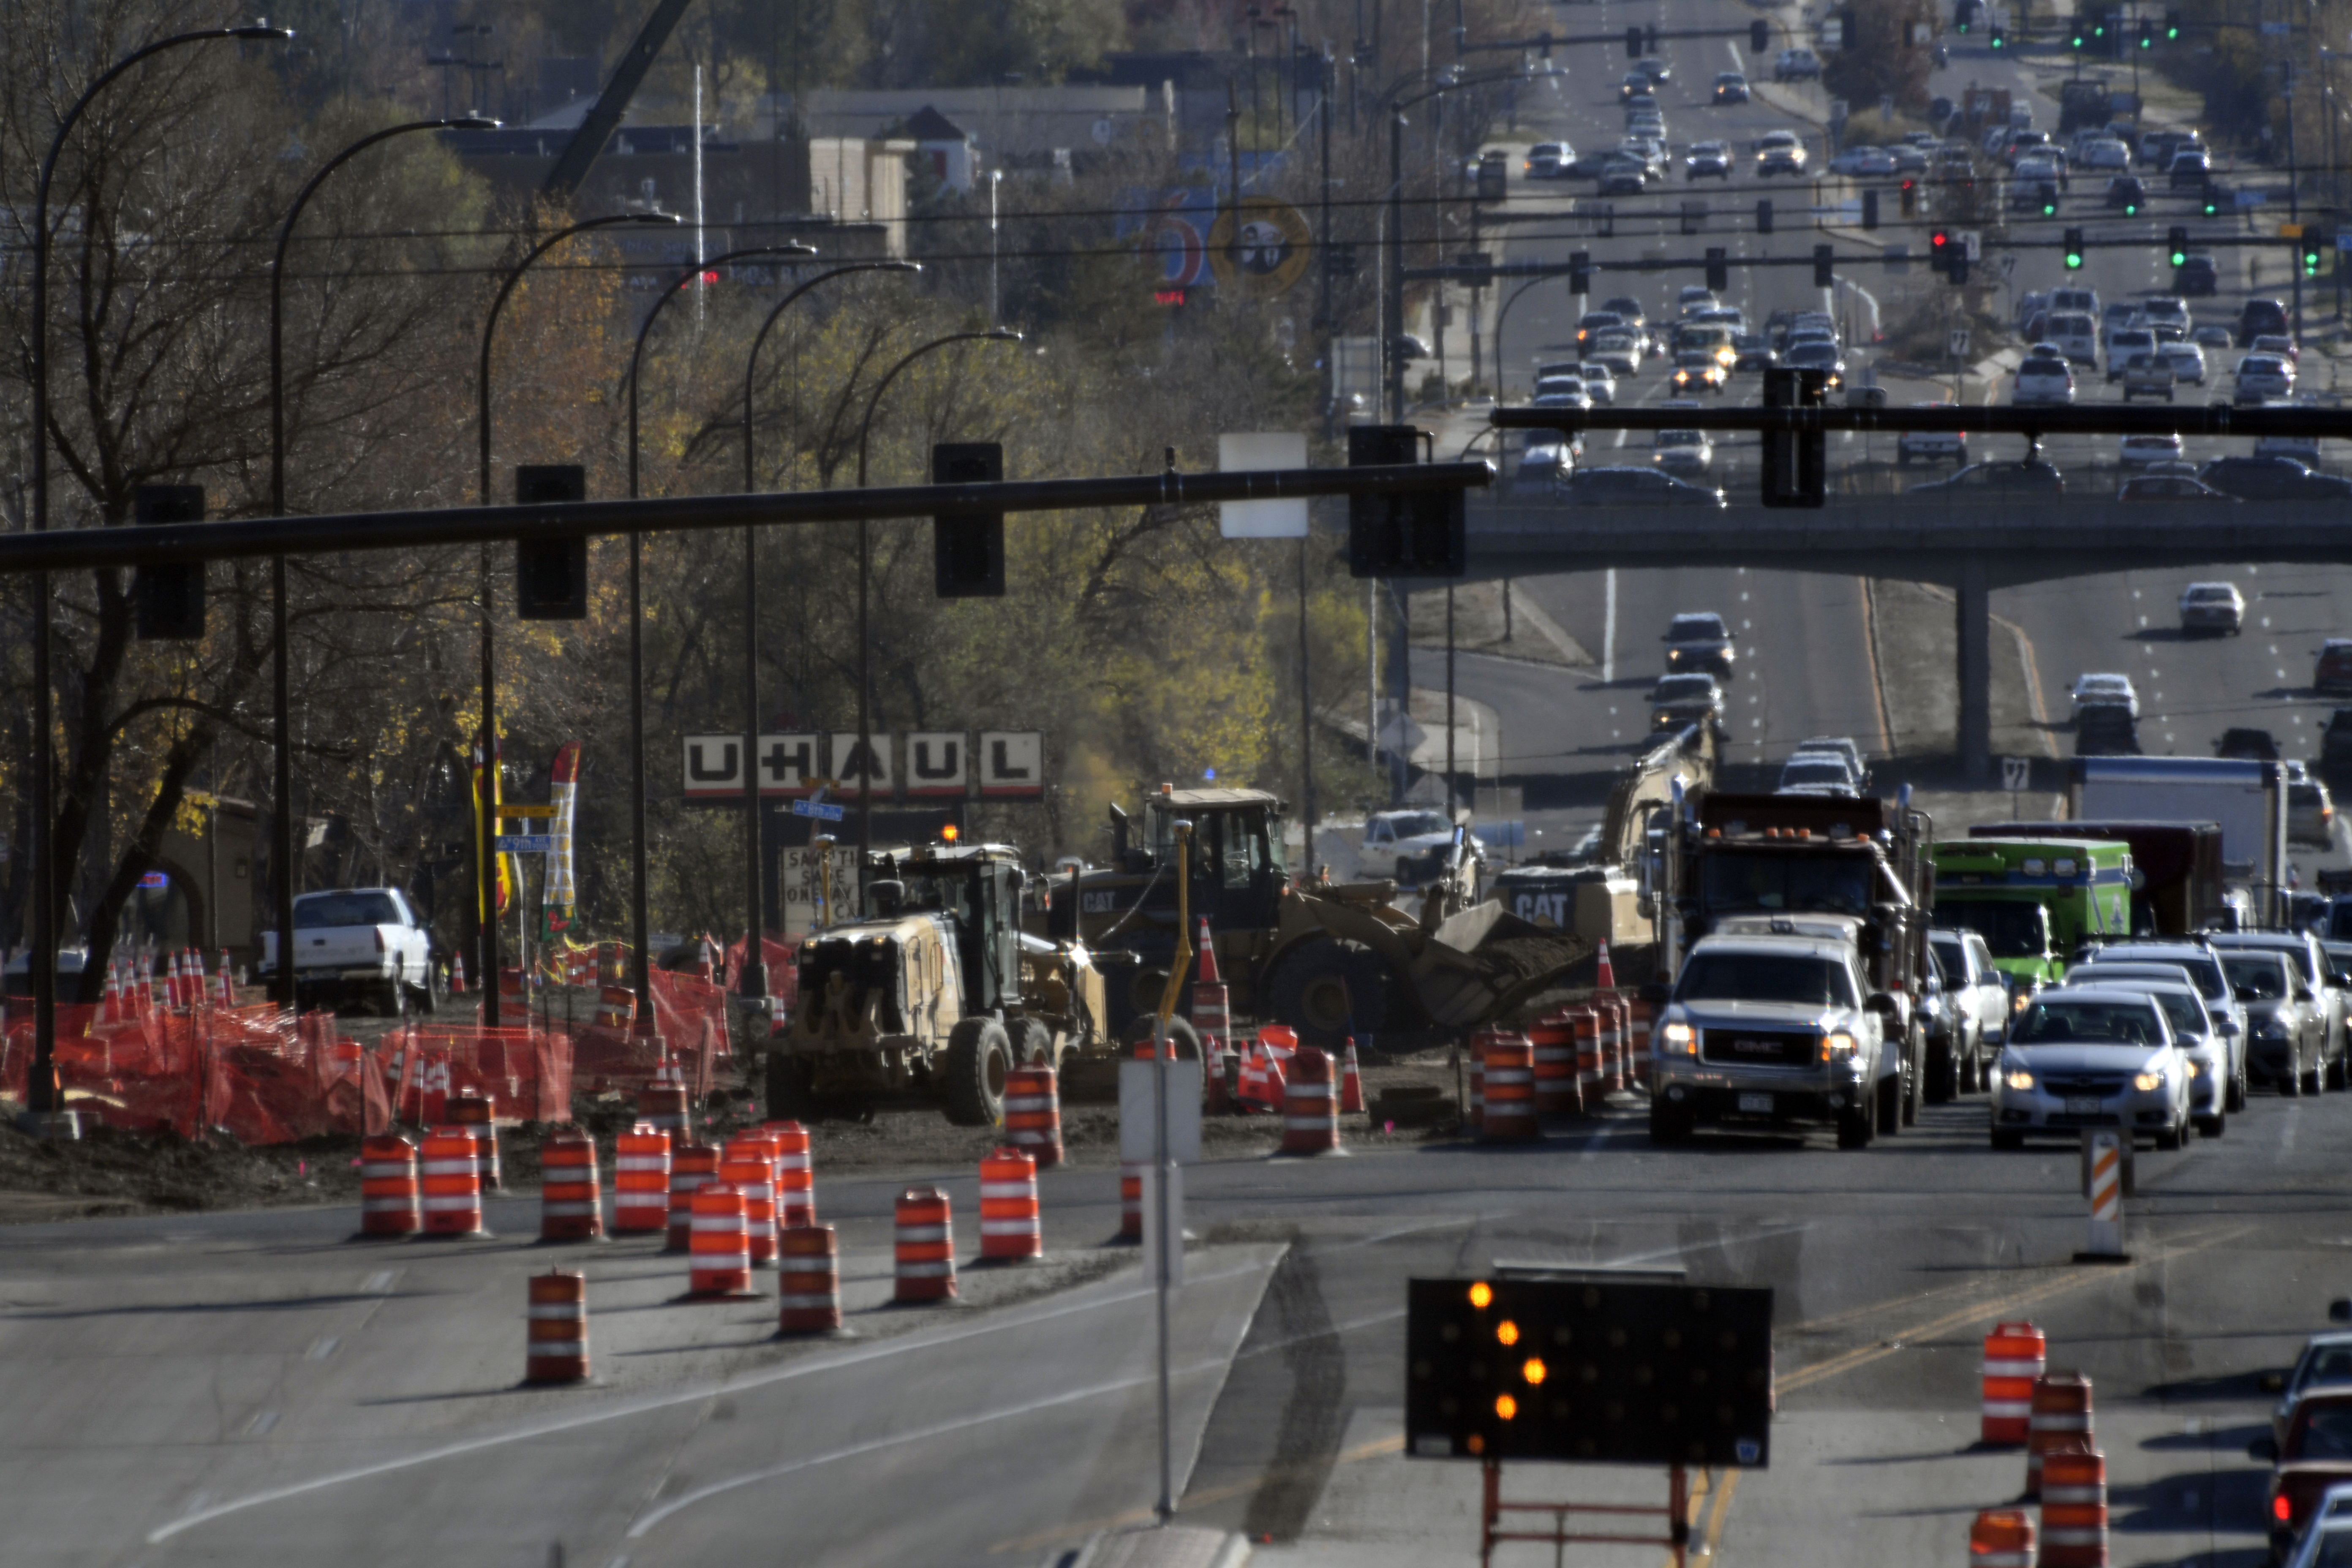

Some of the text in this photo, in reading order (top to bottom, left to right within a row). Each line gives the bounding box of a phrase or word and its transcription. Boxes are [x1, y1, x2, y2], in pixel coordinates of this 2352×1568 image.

[513, 838, 531, 849] 9th
[1083, 891, 1115, 913] CAT
[1515, 893, 1568, 927] CAT
[1734, 1039, 1783, 1054] GMC
